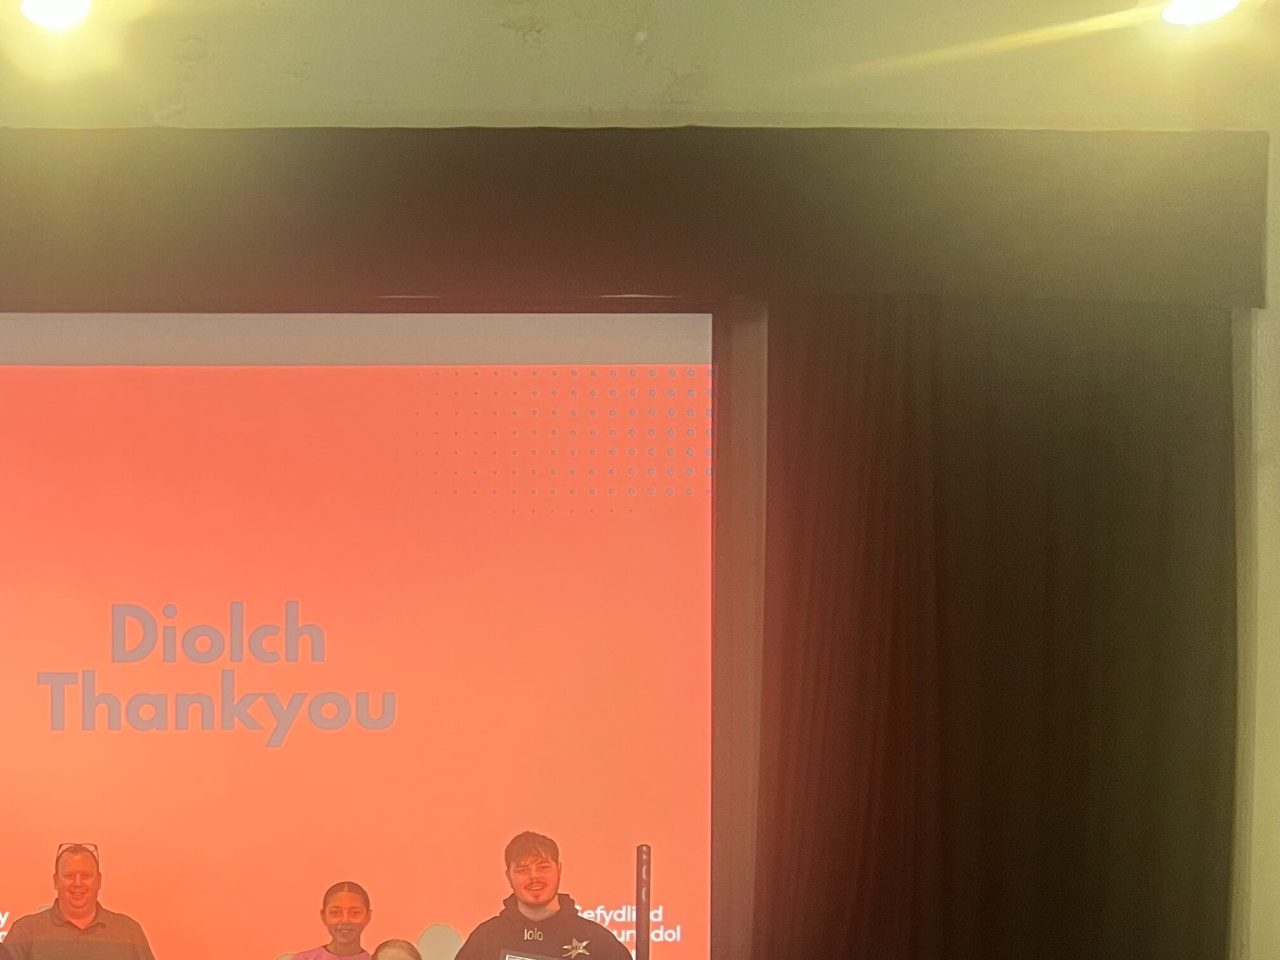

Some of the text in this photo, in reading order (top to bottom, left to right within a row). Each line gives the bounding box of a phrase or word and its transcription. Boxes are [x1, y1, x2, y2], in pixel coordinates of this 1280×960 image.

[111, 600, 326, 664] Diolch
[36, 669, 397, 748] Thankyou
[575, 905, 663, 926] efydlid
